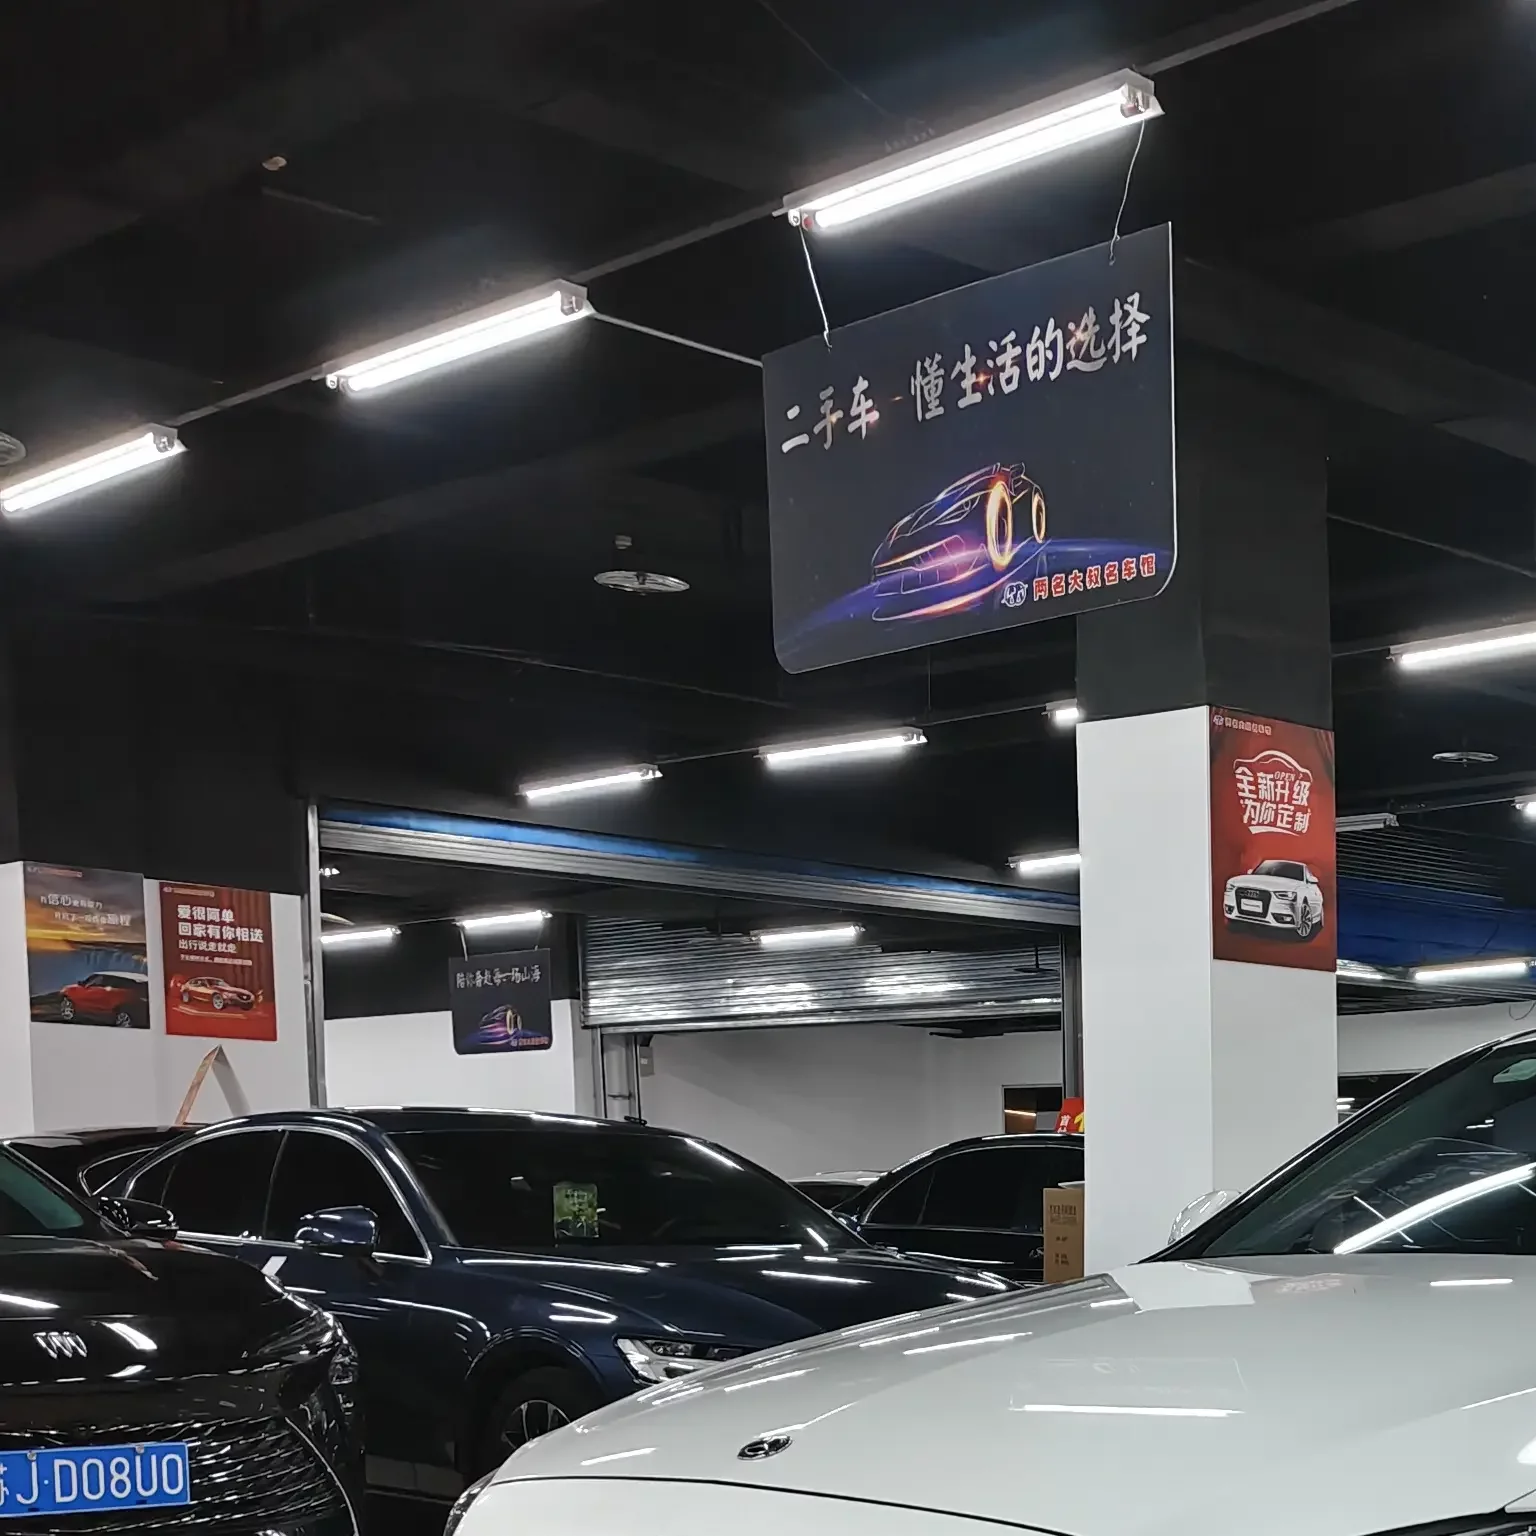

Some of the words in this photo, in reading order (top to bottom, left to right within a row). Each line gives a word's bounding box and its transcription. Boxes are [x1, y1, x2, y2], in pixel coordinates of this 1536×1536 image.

[781, 376, 880, 454] 二手车
[911, 291, 1151, 423] 懂生活的选择
[1033, 553, 1156, 601] 两名大叔名车馆
[1235, 766, 1311, 807] 全新升级
[1274, 771, 1295, 783] OPEN
[1240, 798, 1312, 834] 为你定制
